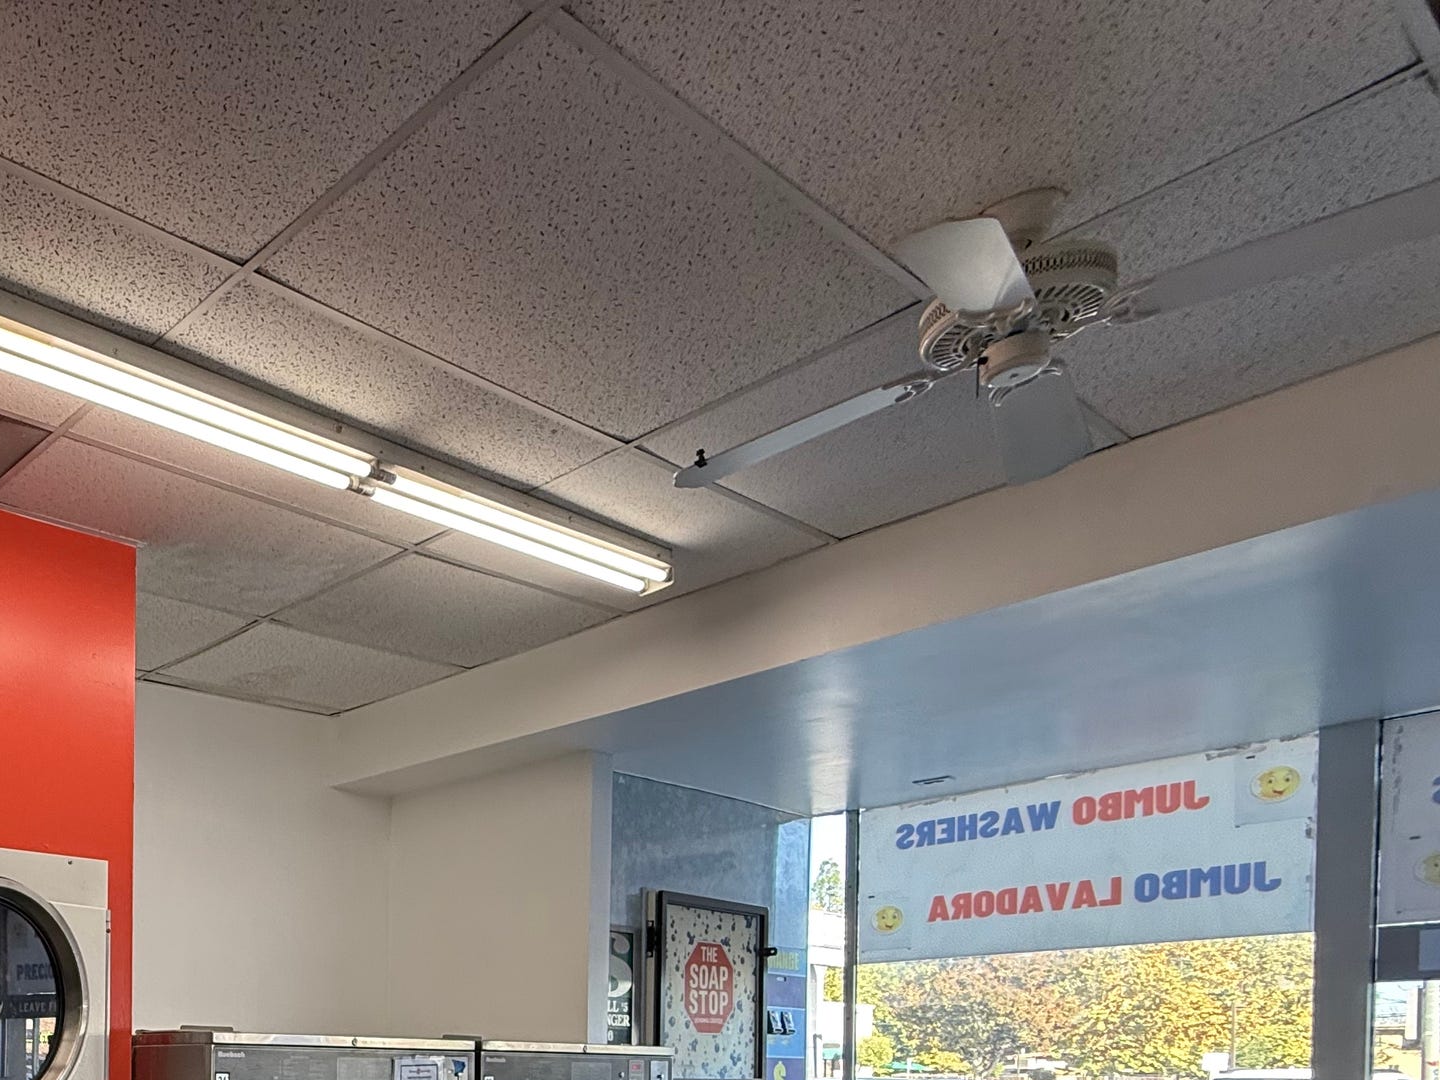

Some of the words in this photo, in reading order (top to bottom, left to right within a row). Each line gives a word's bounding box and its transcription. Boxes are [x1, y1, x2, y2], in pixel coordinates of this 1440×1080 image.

[700, 946, 718, 963] THE
[689, 963, 729, 991] SOAP
[689, 990, 729, 1016] STOP
